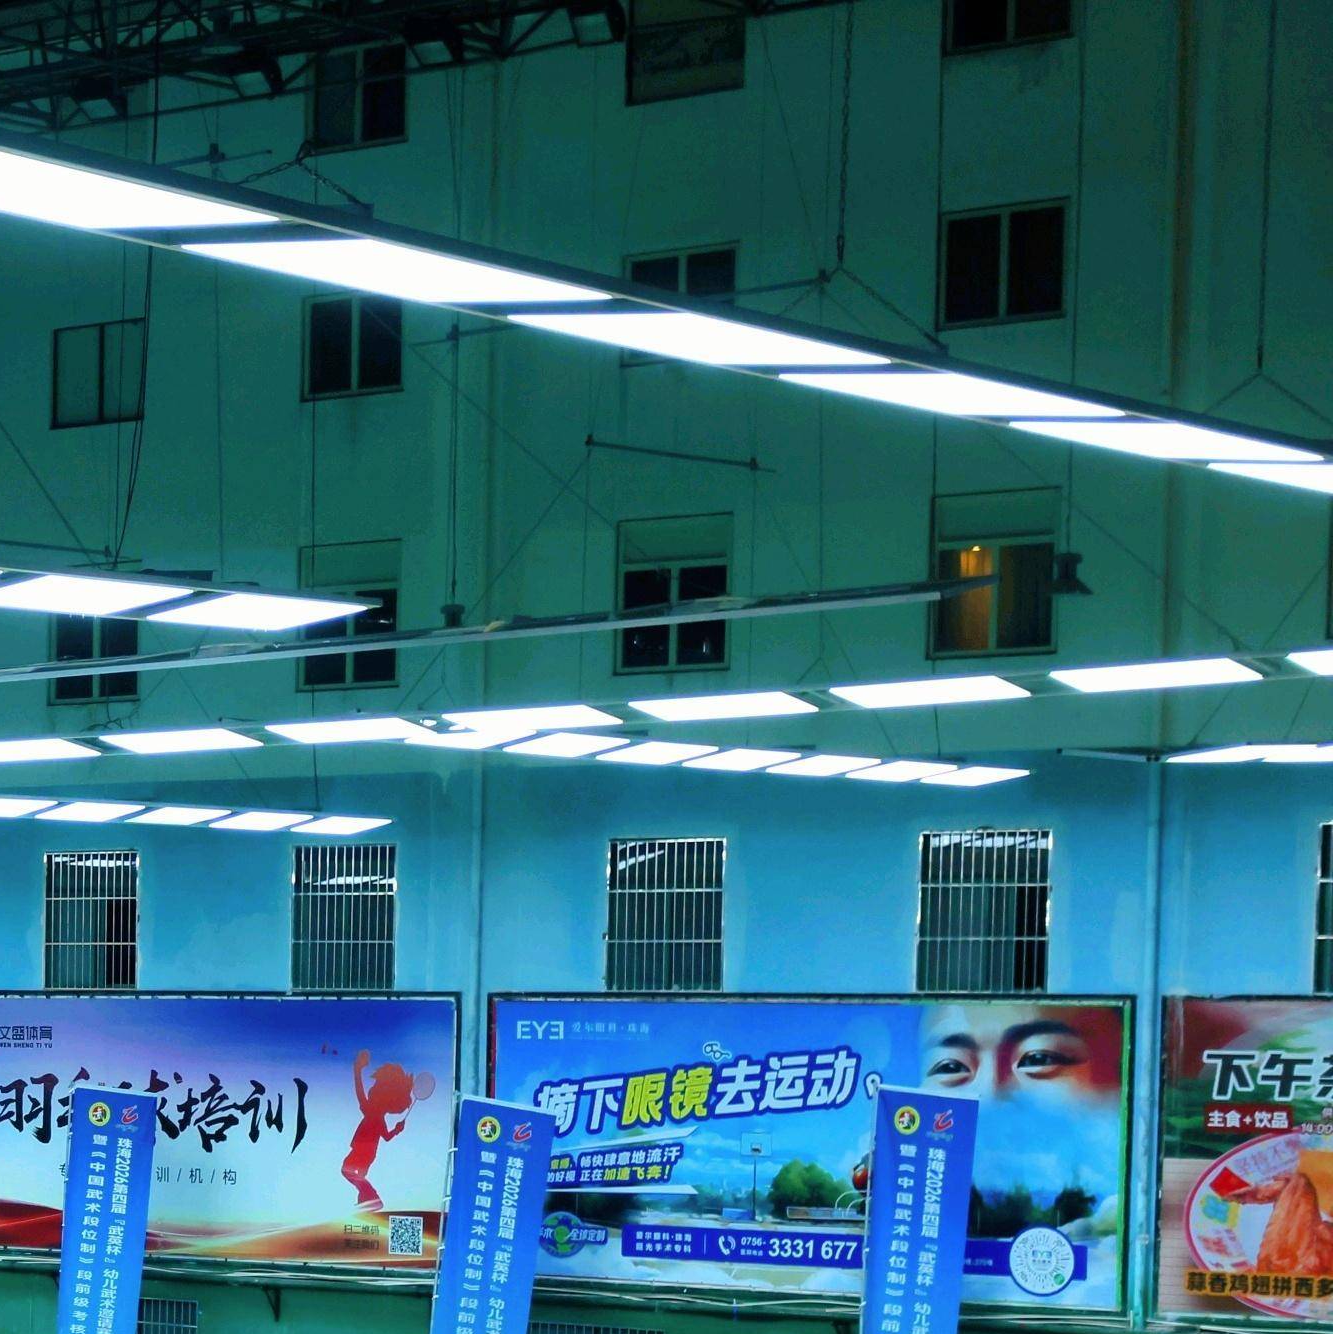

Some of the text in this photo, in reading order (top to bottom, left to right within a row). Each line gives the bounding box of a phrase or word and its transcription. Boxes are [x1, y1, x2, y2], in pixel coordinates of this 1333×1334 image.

[1207, 1110, 1289, 1129] 主食+饮品
[768, 1238, 857, 1261] 3331 677
